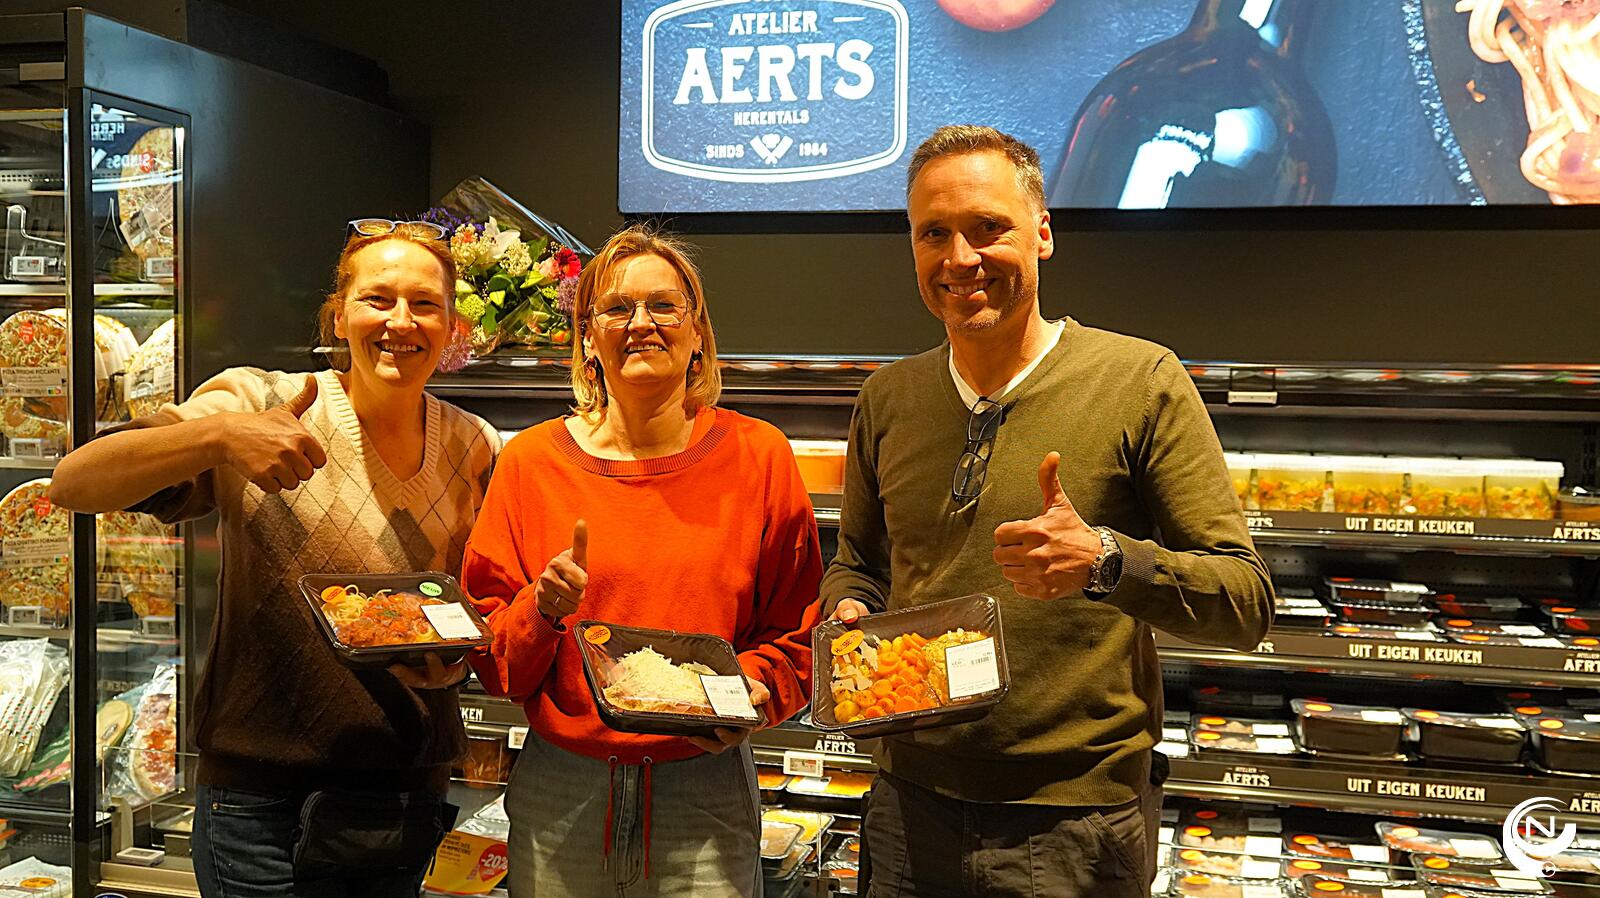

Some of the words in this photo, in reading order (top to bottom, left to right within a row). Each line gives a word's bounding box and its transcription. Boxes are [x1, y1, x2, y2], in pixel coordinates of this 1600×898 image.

[728, 10, 818, 35] ATELIER
[672, 39, 875, 104] AERTS
[733, 110, 810, 126] HERENTALS
[706, 143, 745, 159] SINDS
[798, 142, 828, 156] 1984
[1247, 517, 1274, 528] RTS
[1345, 517, 1368, 530] UIT
[1373, 518, 1414, 532] EIGEN
[1418, 519, 1475, 534] KEUKEN
[1552, 527, 1600, 540] AERTS
[1348, 644, 1373, 658] UIT
[1377, 645, 1419, 660] EIGEN
[1424, 647, 1482, 664] KEUKEN
[1563, 658, 1600, 673] AERT
[461, 707, 483, 721] KEN
[815, 740, 856, 753] AERTS
[1222, 772, 1270, 787] AERTS
[1347, 778, 1372, 792] UIT
[1377, 780, 1420, 797] EIGEN
[1425, 784, 1485, 801] KEUKEN
[1569, 798, 1600, 813] AER
